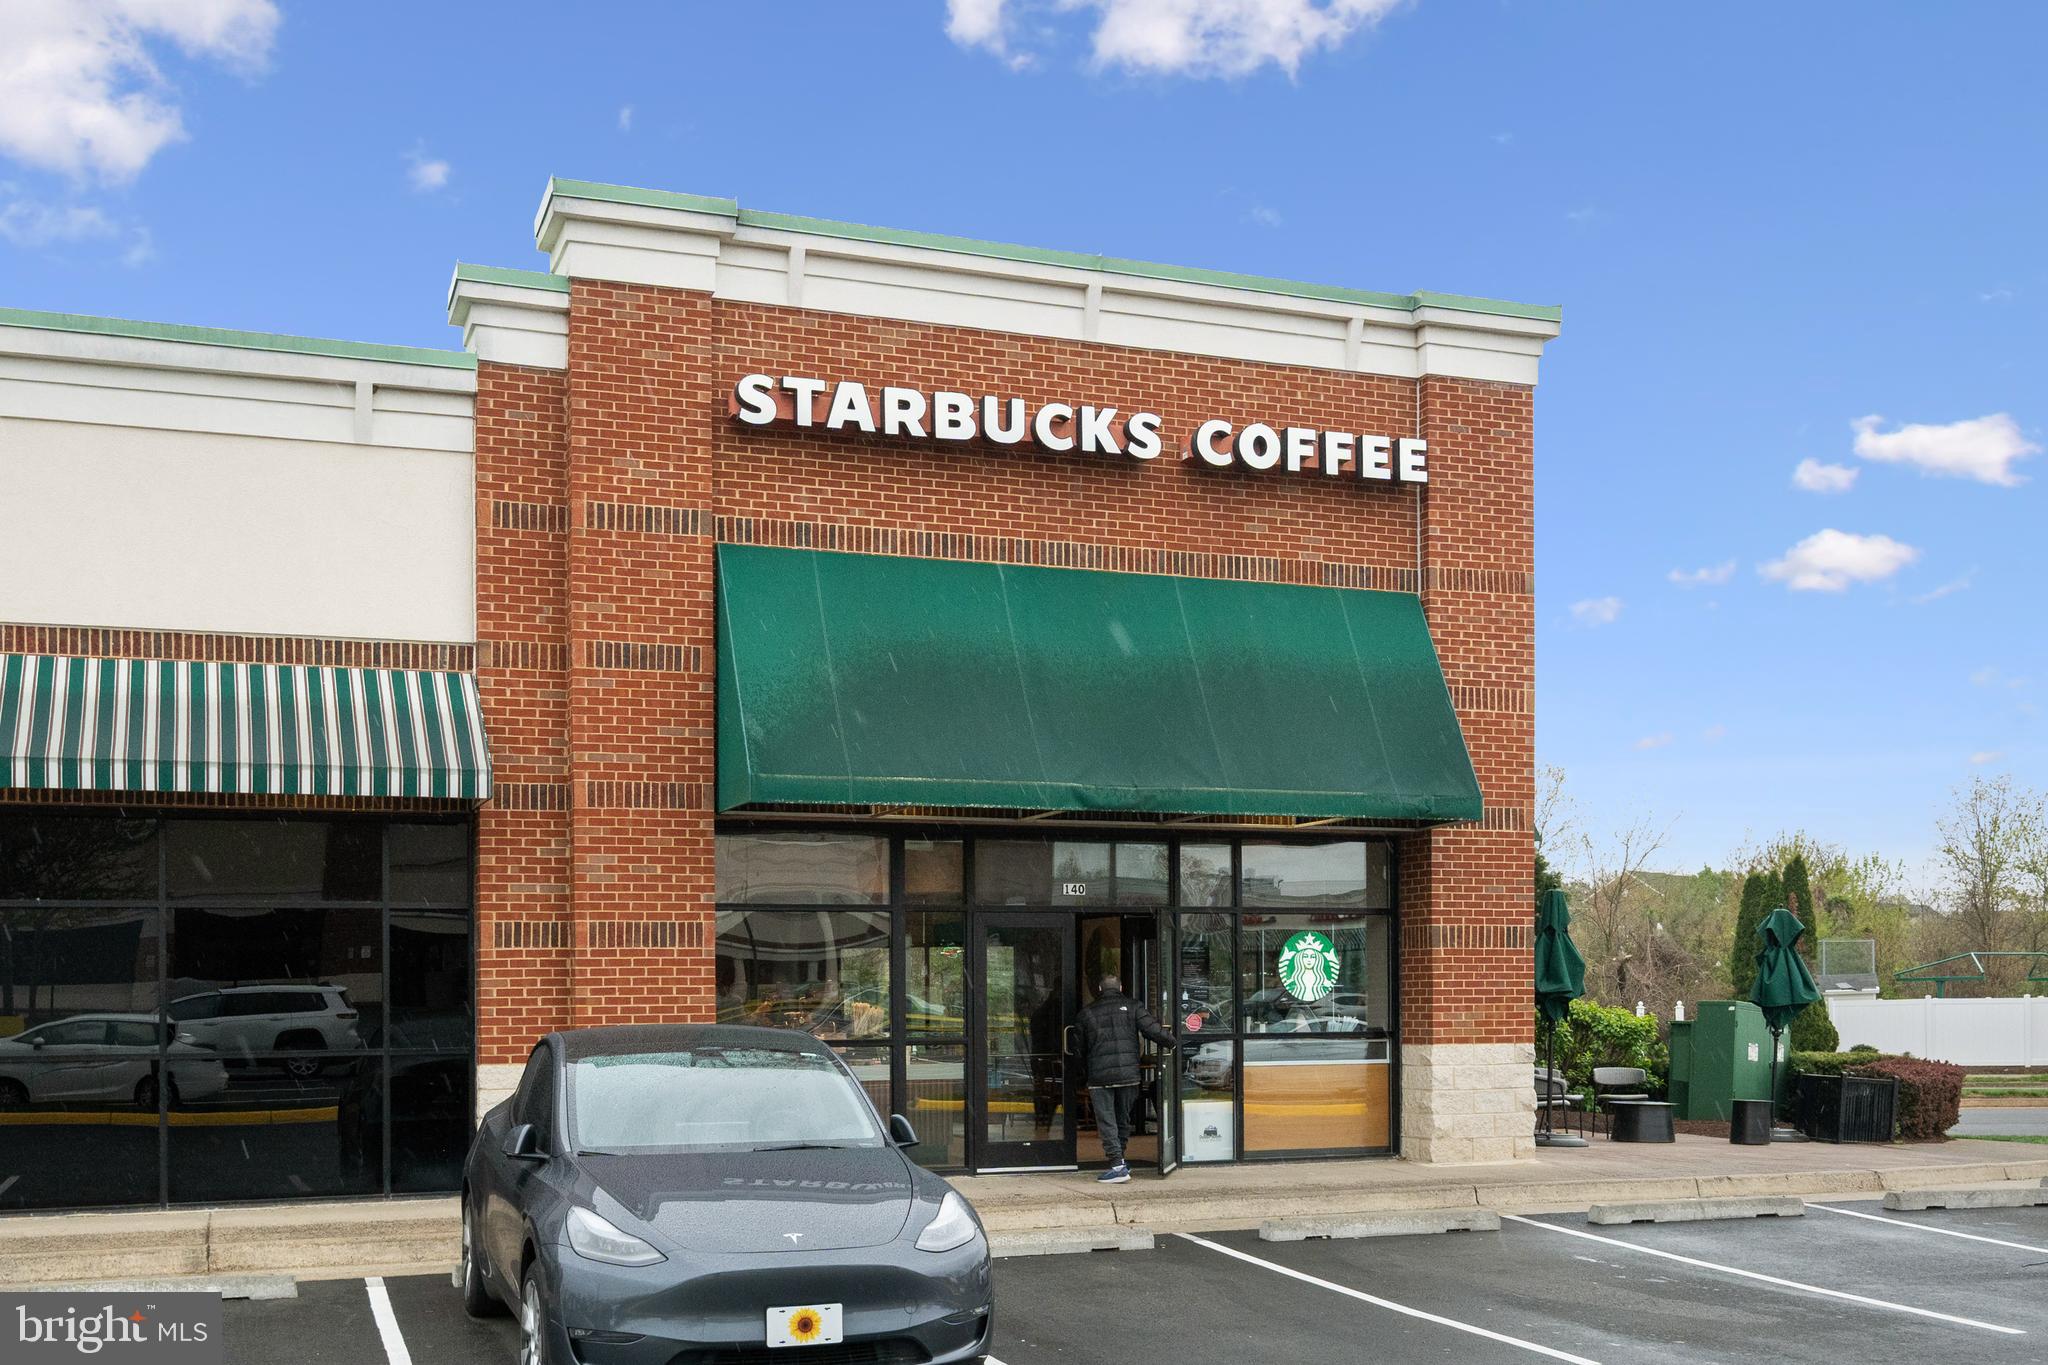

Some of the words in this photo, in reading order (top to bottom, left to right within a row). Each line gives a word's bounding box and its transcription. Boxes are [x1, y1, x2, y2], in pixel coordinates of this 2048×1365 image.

[736, 373, 1163, 460] STARBUCKS
[1195, 417, 1429, 484] COFFEE
[1064, 884, 1085, 895] 140
